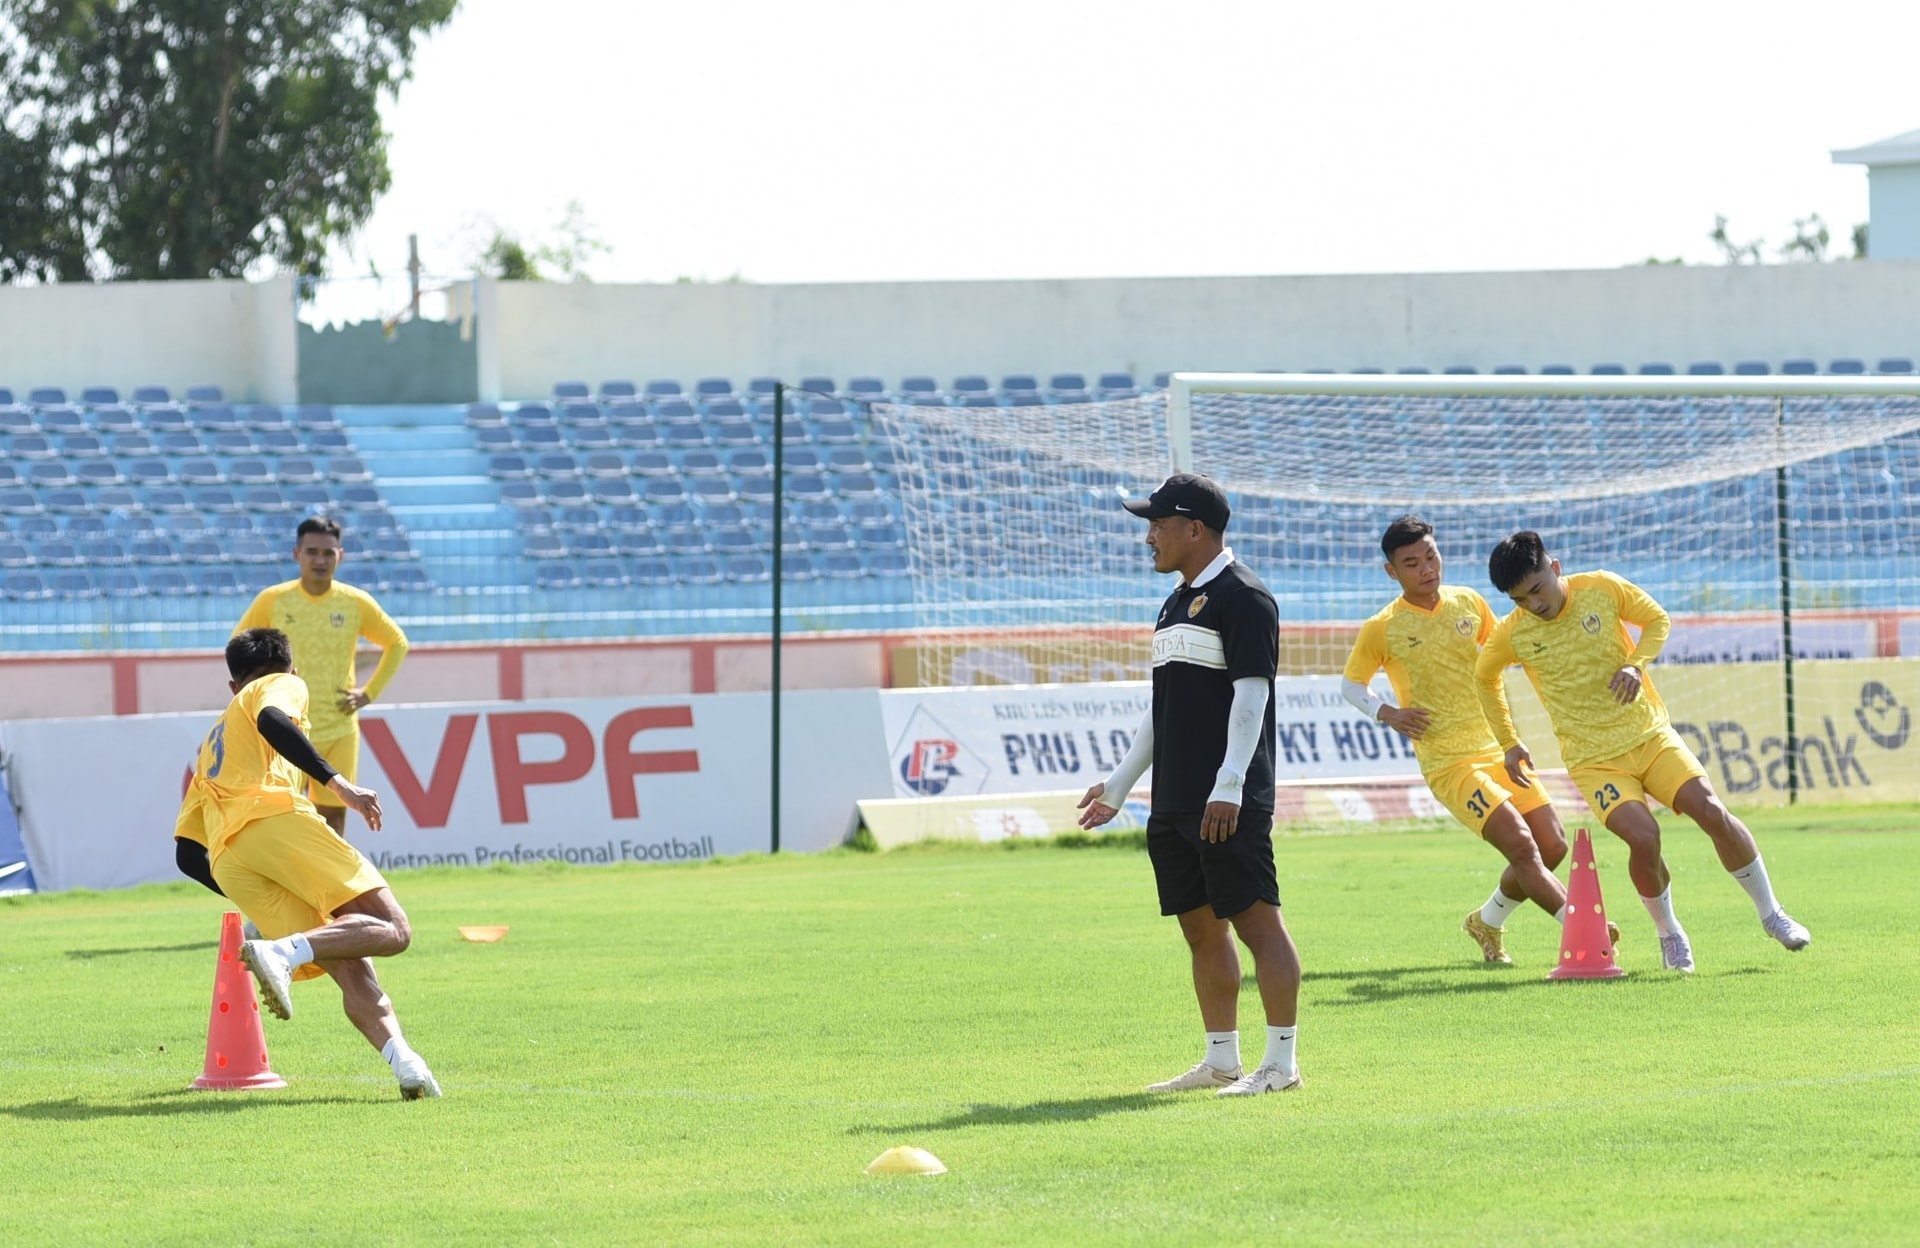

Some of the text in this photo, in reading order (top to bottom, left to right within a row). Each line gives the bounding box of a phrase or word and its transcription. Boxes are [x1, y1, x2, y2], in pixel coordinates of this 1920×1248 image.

[1002, 728, 1139, 775] PHU LO
[1277, 721, 1321, 763] KY
[359, 705, 700, 829] VPF
[1466, 788, 1491, 819] 37
[1594, 783, 1621, 812] 23
[369, 835, 715, 872] Vietnam Professional Football
